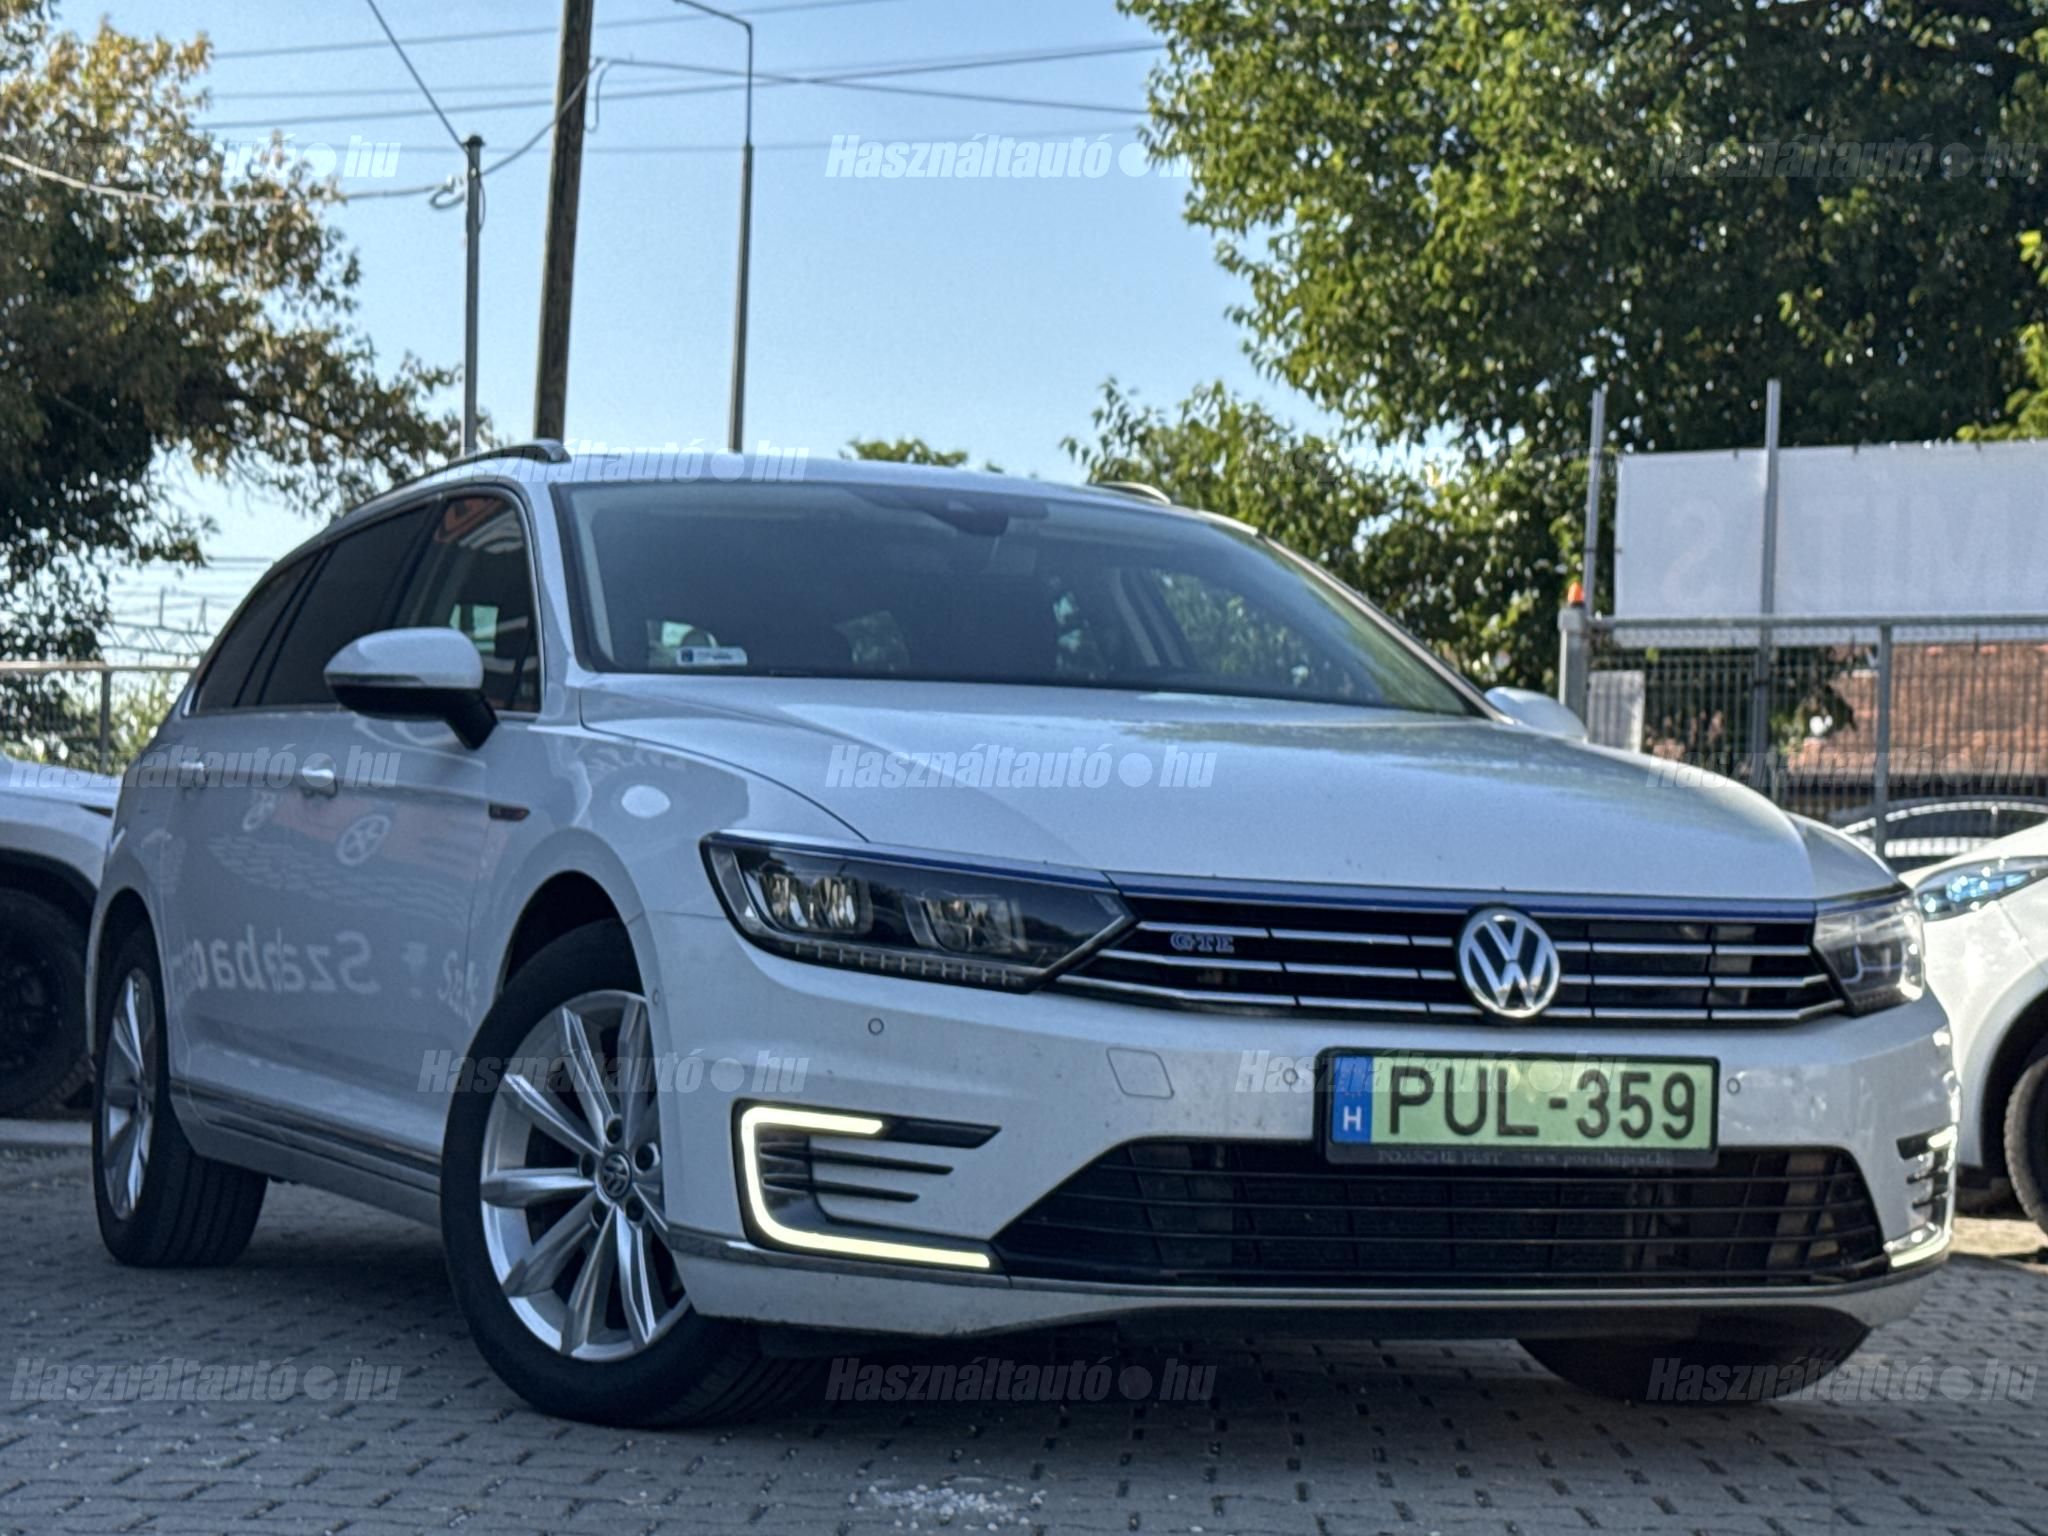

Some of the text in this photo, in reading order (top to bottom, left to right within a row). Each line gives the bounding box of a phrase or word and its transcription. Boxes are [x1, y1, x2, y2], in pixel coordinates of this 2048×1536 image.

[1170, 932, 1235, 953] GTE
[1389, 1065, 1696, 1140] PUL-359
[1342, 1105, 1363, 1132] H
